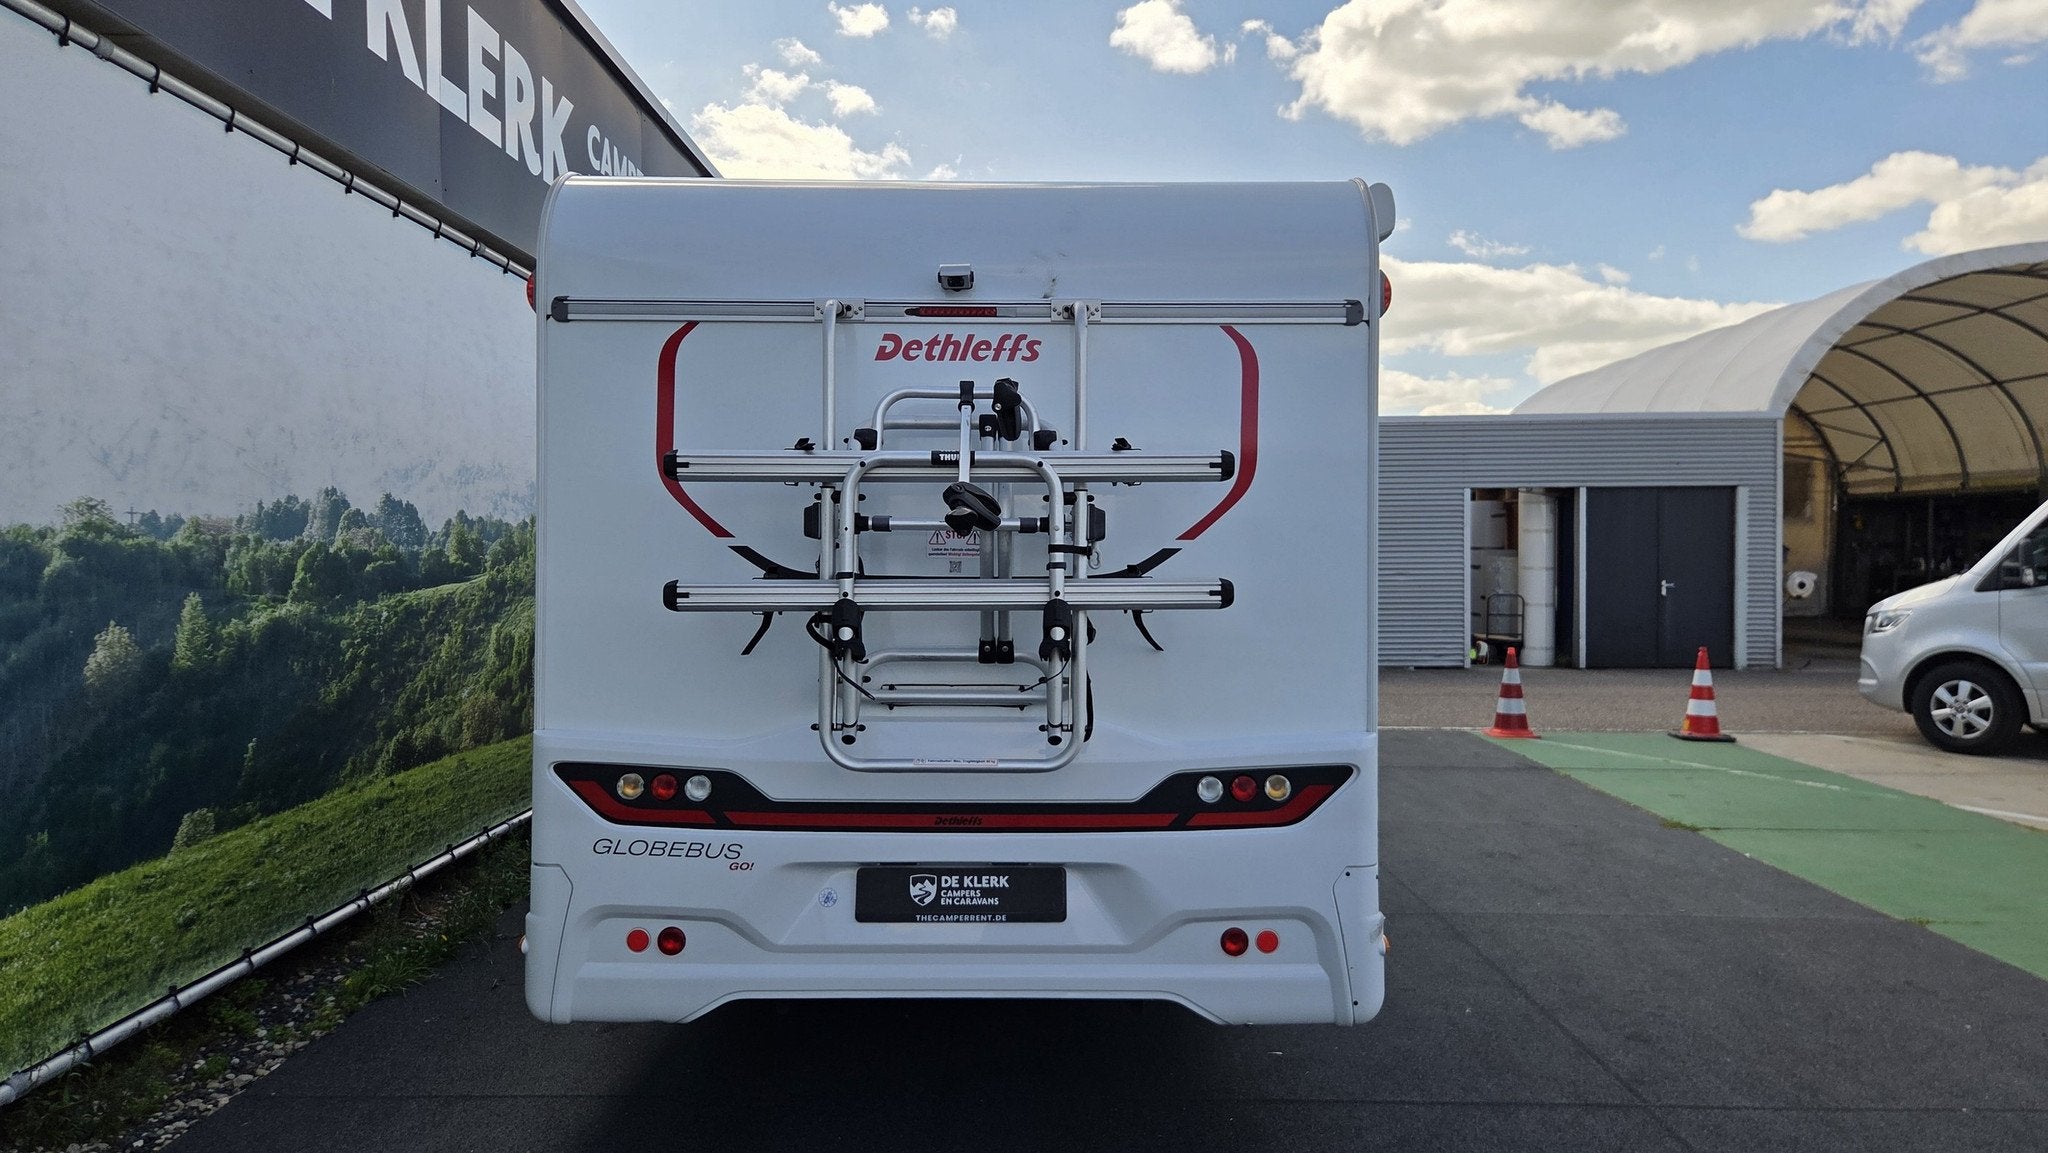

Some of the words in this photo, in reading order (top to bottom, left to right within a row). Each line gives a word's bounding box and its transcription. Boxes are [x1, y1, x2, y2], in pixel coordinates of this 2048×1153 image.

[875, 333, 1042, 361] Dethleffs
[934, 815, 983, 826] Dethleffs
[592, 838, 744, 860] GLOBEBUS
[729, 861, 755, 871] GO!
[941, 875, 960, 888] DE
[964, 875, 1010, 888] KLERK
[941, 889, 981, 897] CAMPERS
[941, 897, 954, 905] EN
[954, 897, 999, 905] CARAVANS
[915, 914, 1007, 922] THECAMPERRENT.DE
